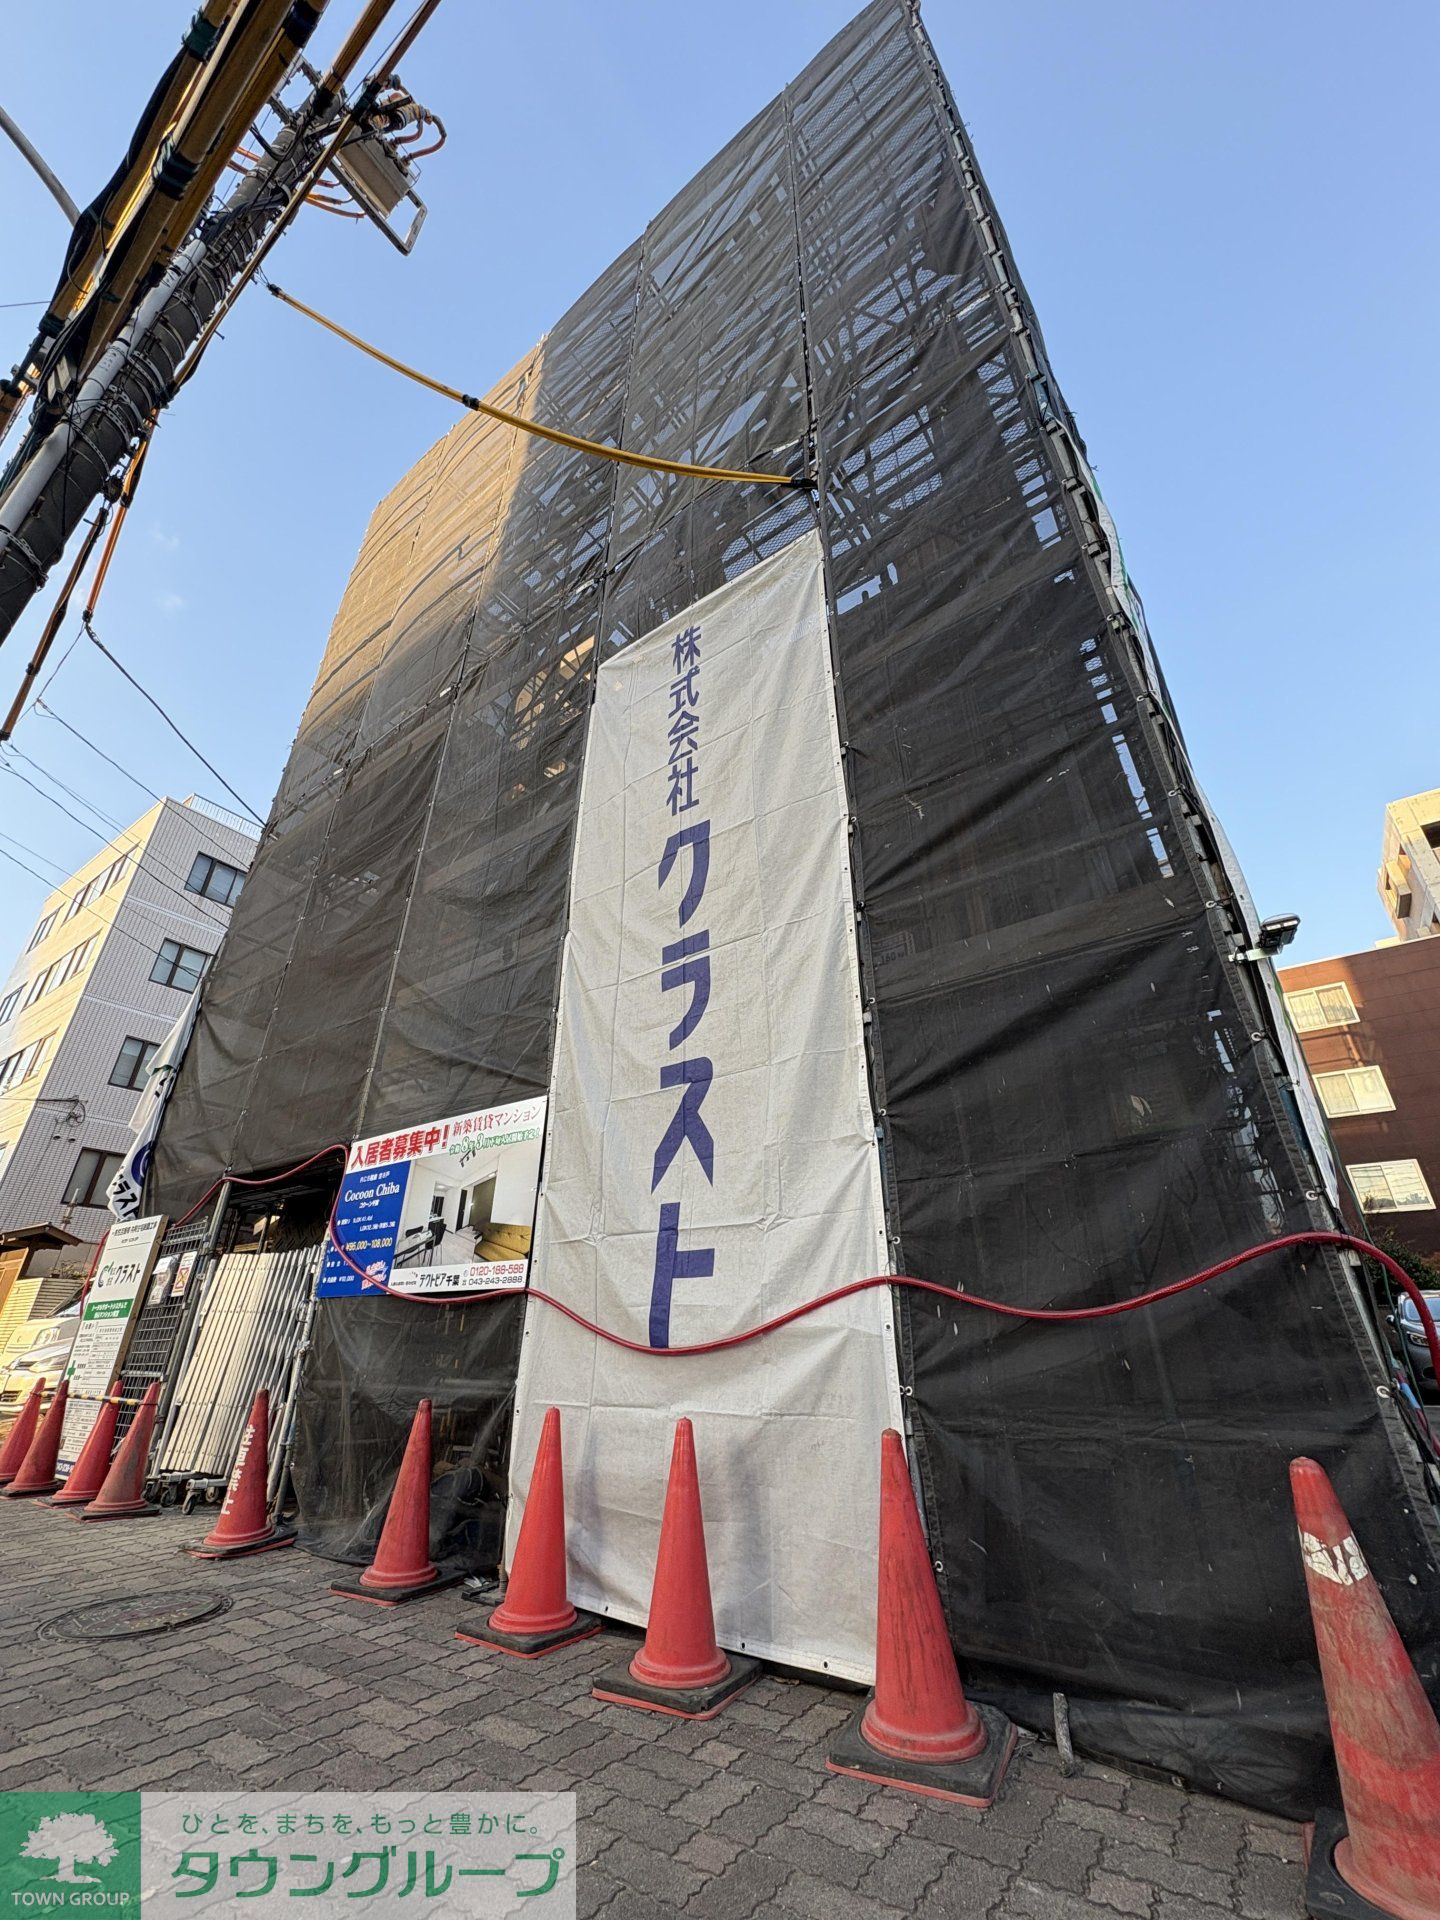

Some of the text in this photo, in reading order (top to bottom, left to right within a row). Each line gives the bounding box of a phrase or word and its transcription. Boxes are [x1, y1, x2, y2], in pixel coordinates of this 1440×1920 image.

[453, 1105, 541, 1137] 新築賃貸マンション
[351, 1124, 450, 1169] 入居者募集中！
[112, 1173, 139, 1218] ラスト
[345, 1182, 400, 1202] Cocoon Chiba
[420, 1273, 460, 1287] テクトピア千葉
